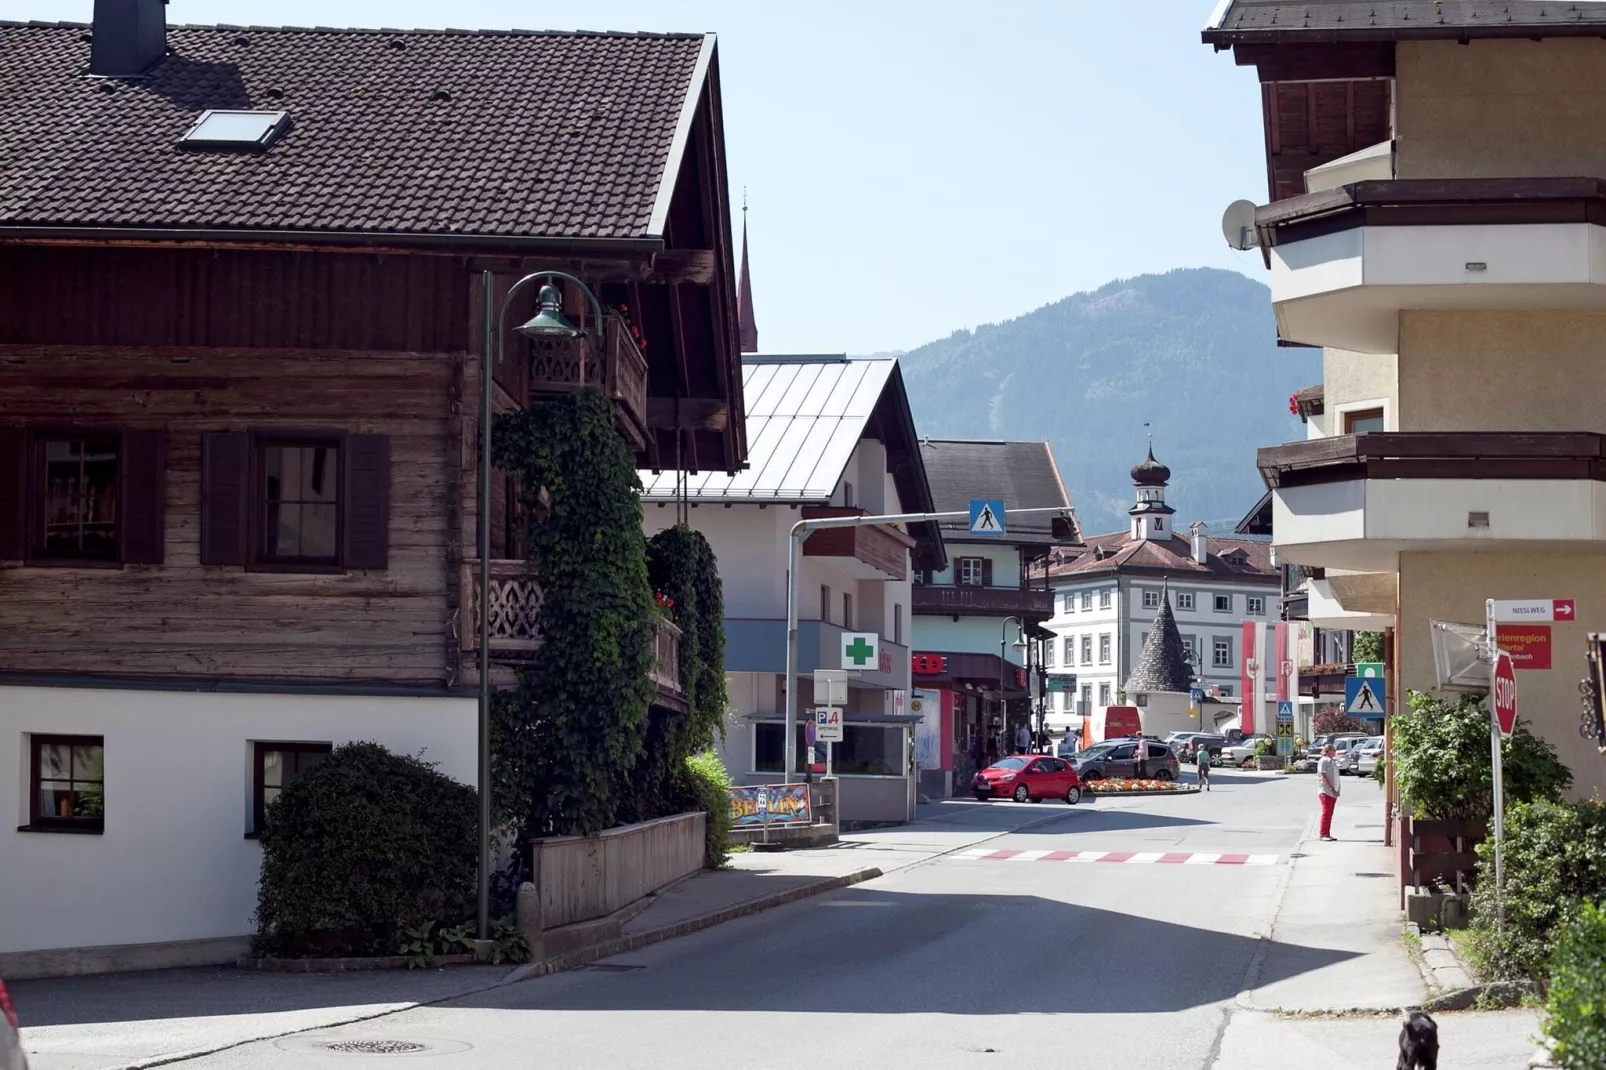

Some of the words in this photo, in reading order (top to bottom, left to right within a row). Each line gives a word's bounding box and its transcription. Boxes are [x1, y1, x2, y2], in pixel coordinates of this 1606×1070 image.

[1512, 606, 1546, 614] NISSLWEG
[1498, 634, 1546, 644] rienregion
[1496, 676, 1515, 711] STOP
[818, 712, 826, 723] P
